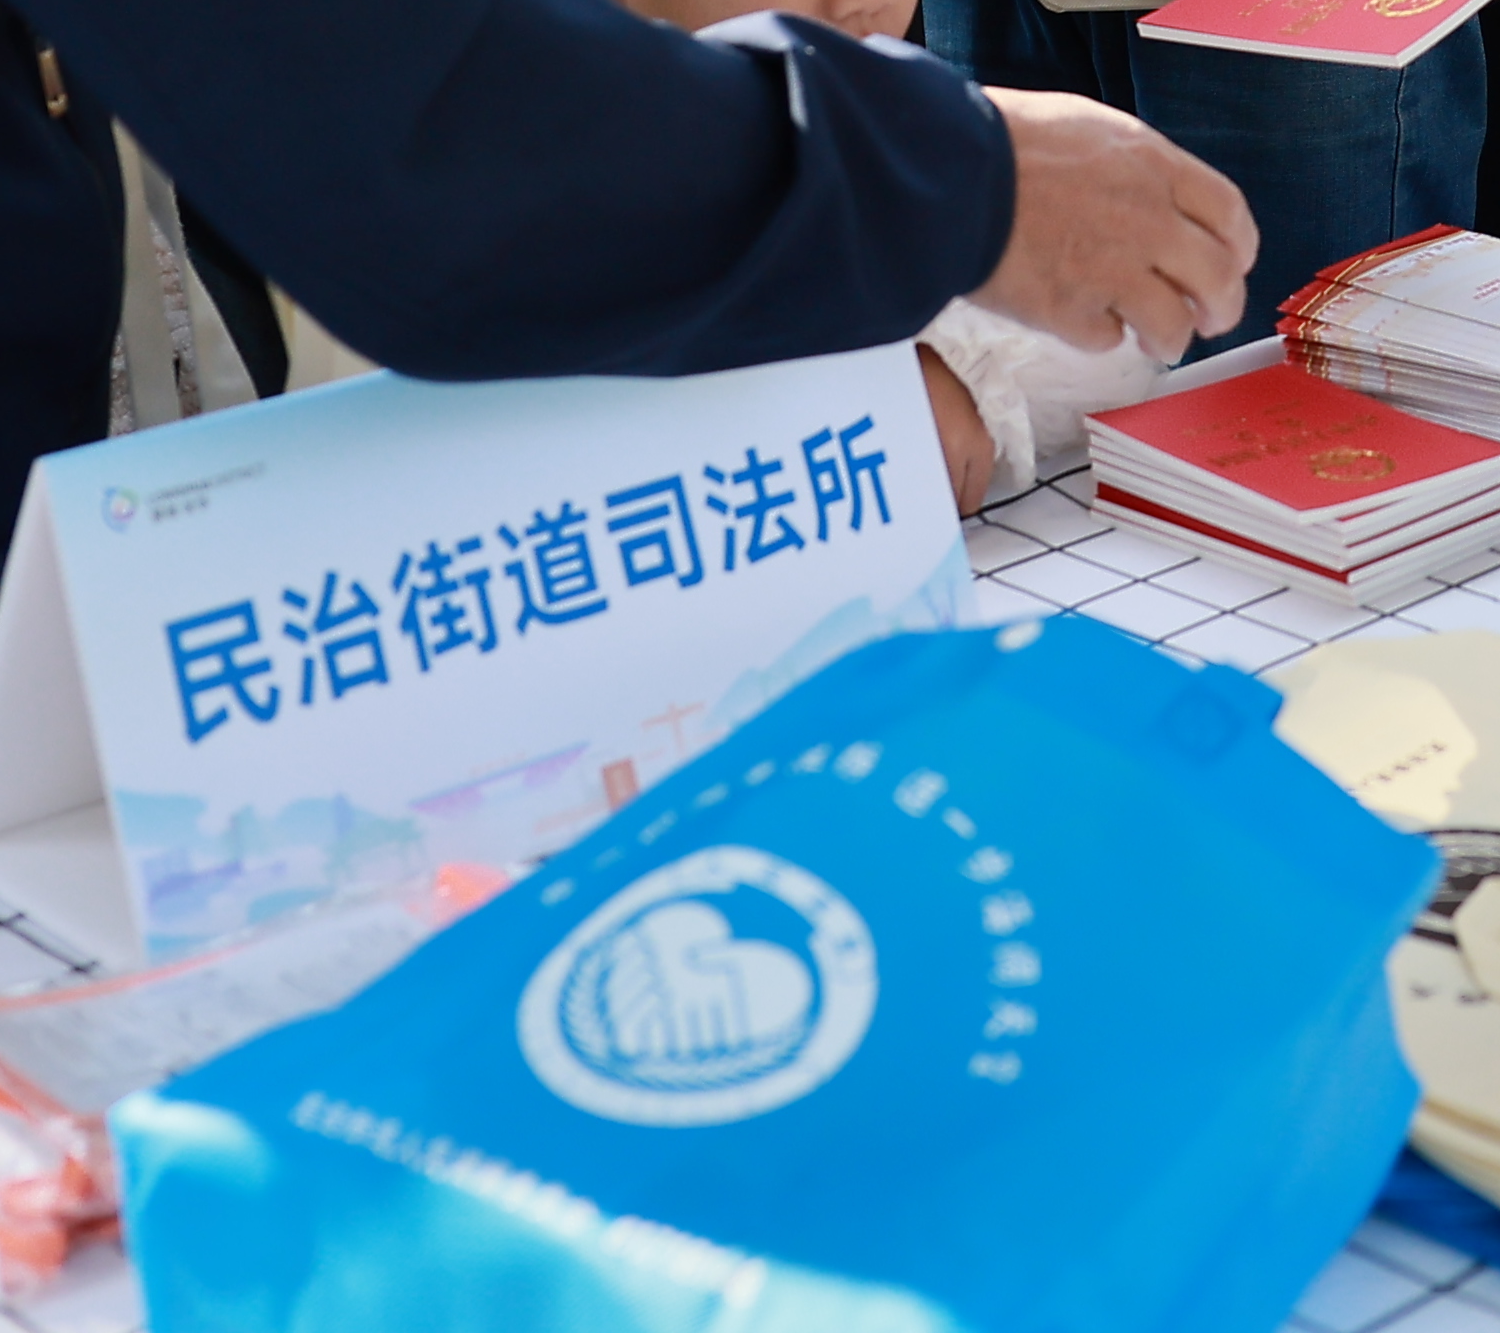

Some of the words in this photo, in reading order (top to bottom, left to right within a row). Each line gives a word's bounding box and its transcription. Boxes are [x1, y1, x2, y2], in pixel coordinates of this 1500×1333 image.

[164, 413, 893, 745] 民治街道司法所
